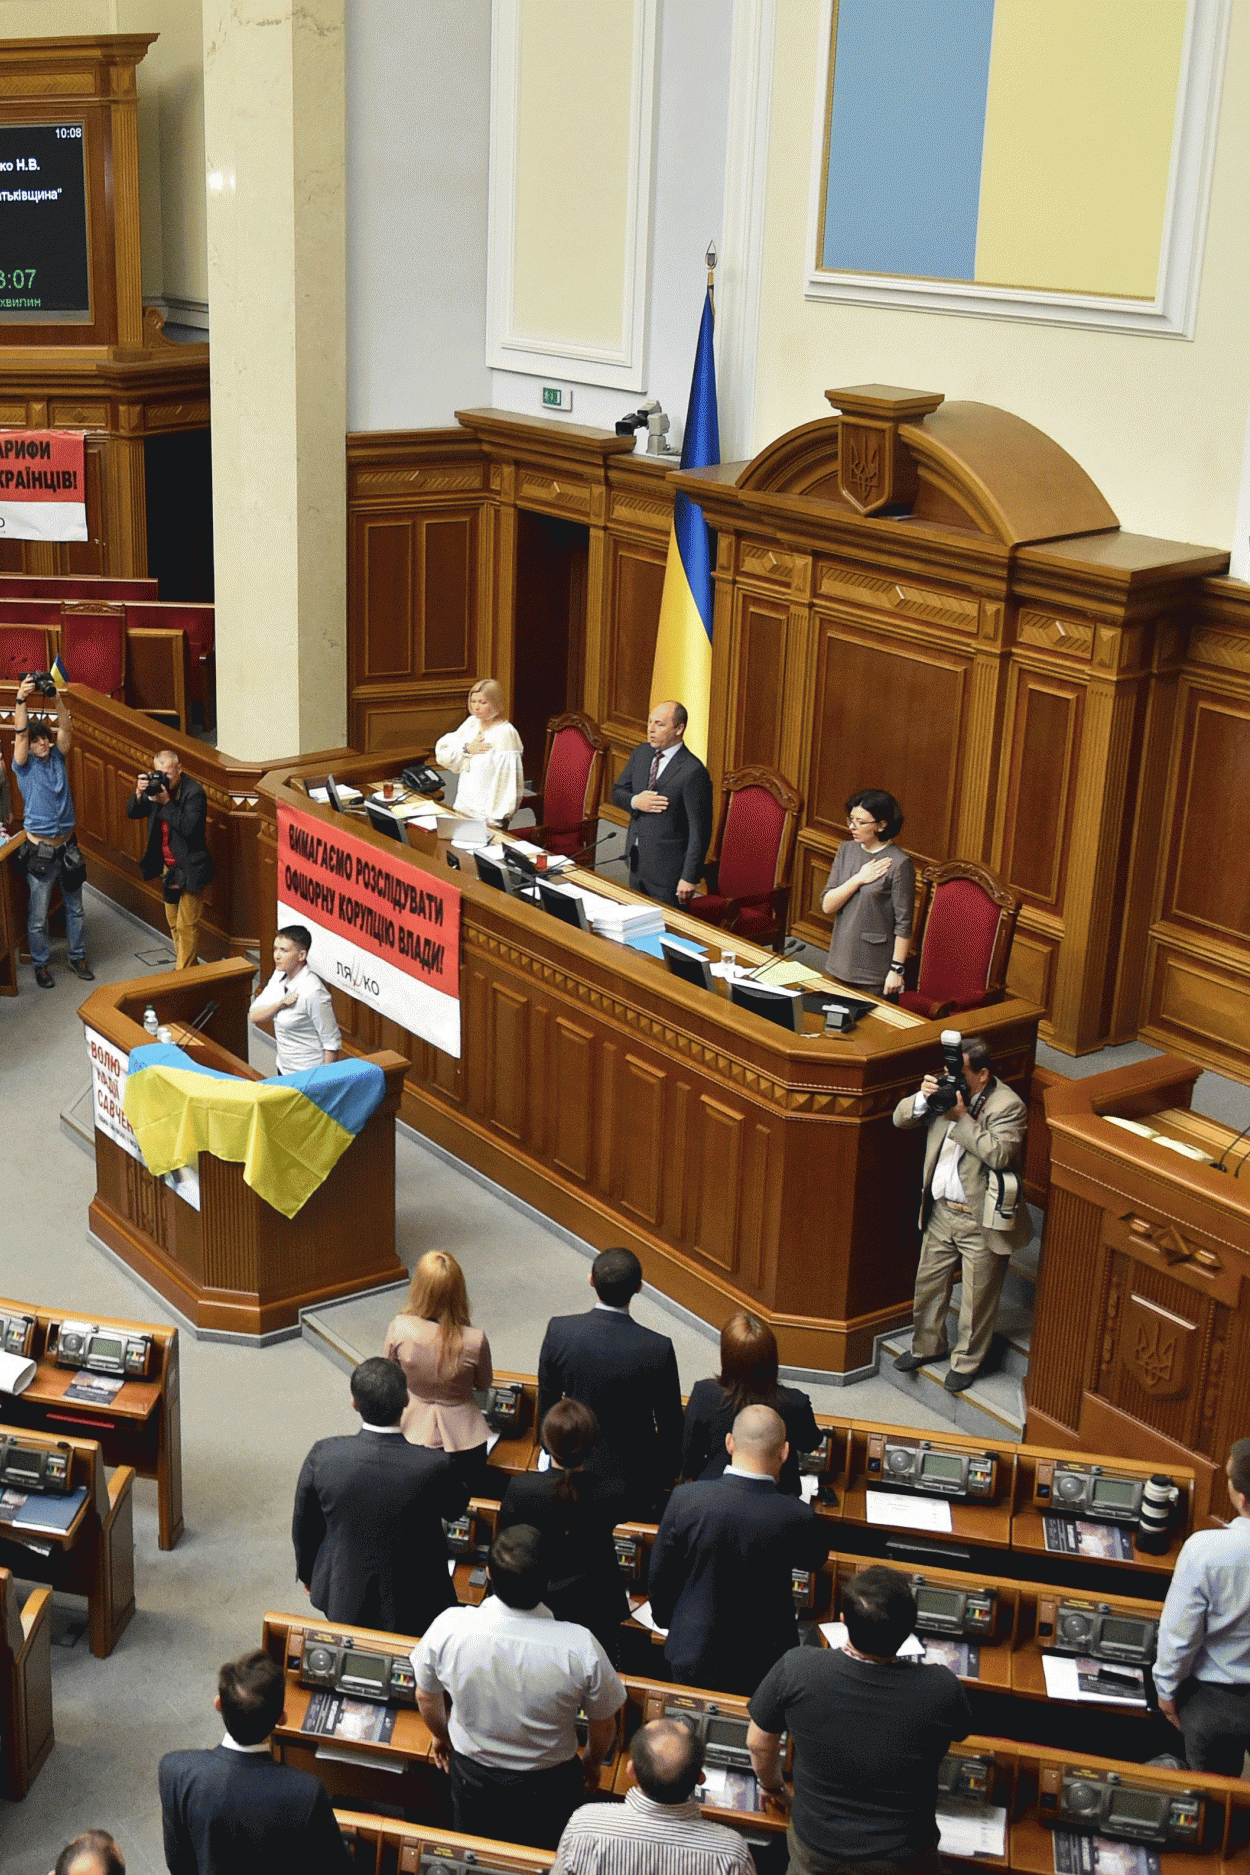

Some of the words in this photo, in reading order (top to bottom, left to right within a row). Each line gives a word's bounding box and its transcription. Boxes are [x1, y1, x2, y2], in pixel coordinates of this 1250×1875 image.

[55, 128, 82, 139] 10:08
[16, 157, 41, 171] Н.В.
[0, 297, 42, 308] хвилин
[288, 823, 354, 880] ВИМАГАЄМО
[355, 859, 444, 928] РОЗСЛІДУВАТИ
[284, 865, 336, 917] ОФШОРНУ
[338, 892, 395, 948] КОРУПЦІЮ
[398, 924, 445, 976] ВЛАДИ!
[91, 1041, 121, 1078] ВОЛЮ
